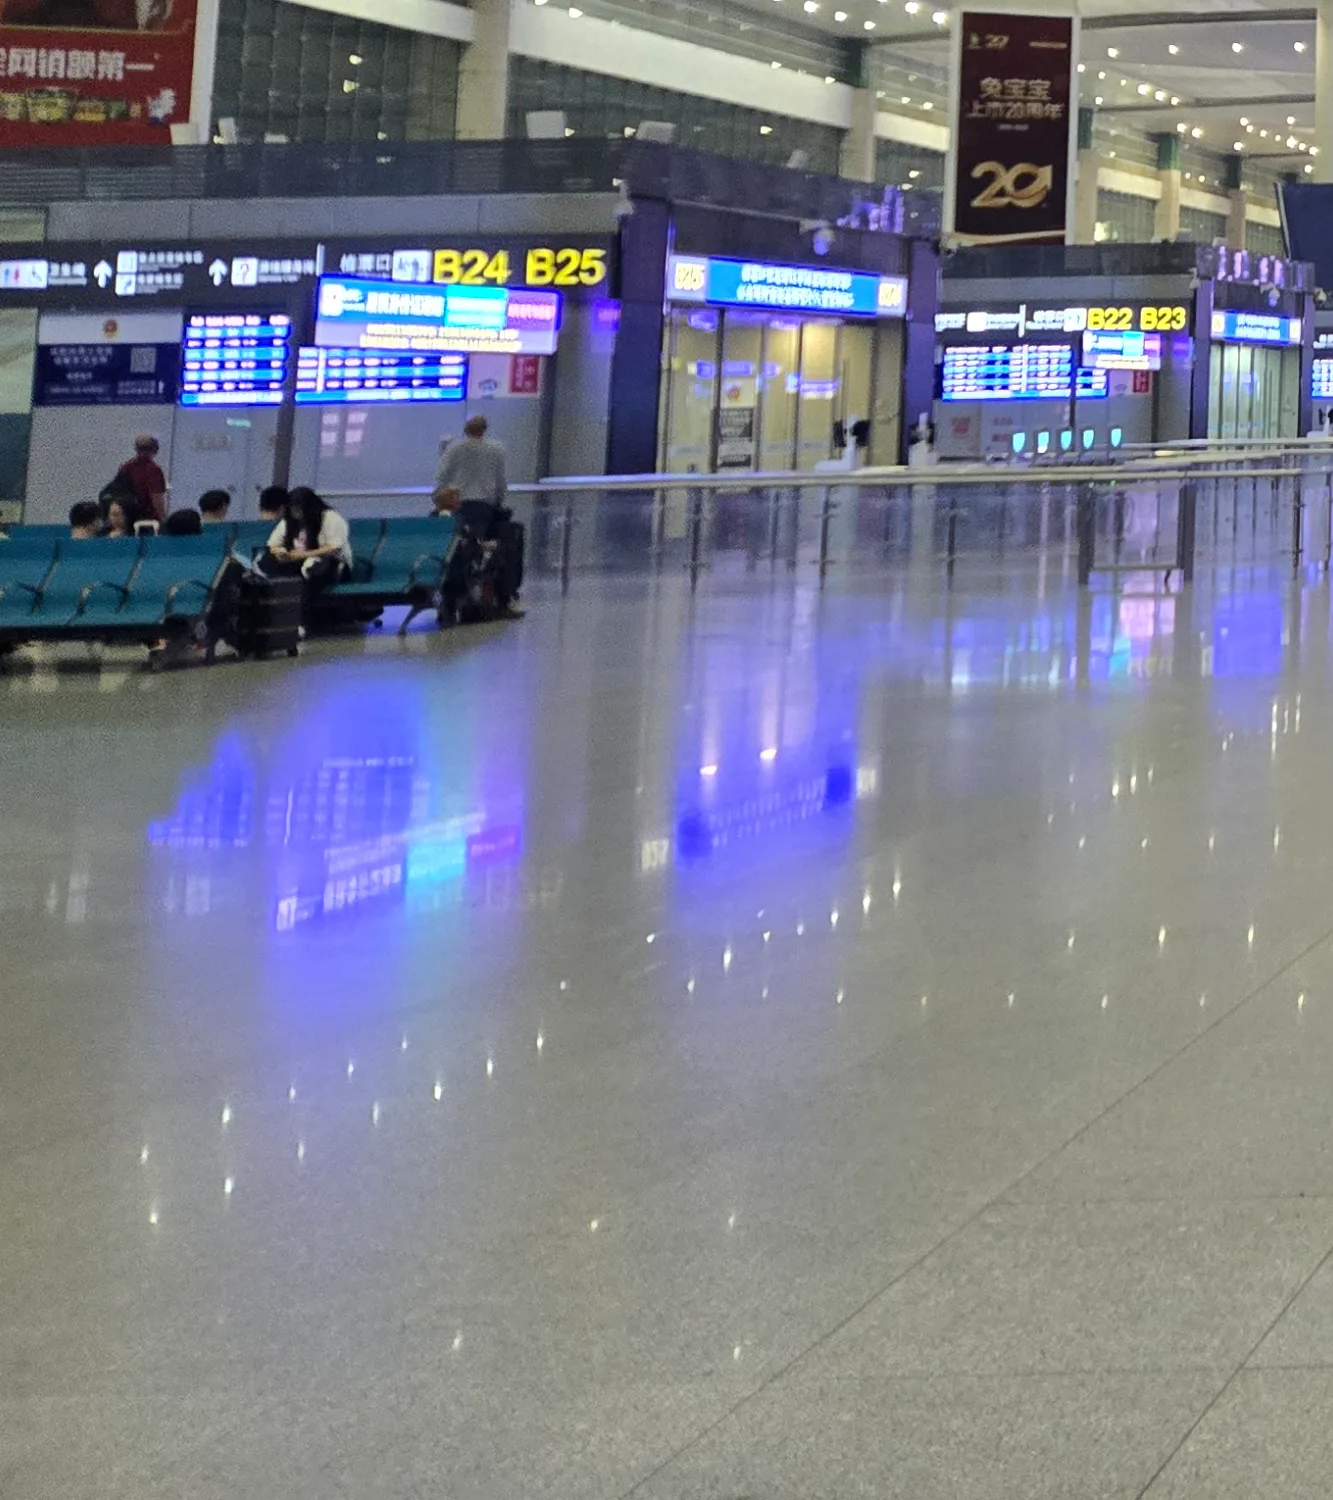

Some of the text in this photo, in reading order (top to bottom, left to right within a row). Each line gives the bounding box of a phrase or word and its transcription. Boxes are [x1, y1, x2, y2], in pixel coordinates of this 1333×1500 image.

[971, 161, 1053, 208] 20
[432, 248, 608, 285] B24 B25
[1088, 307, 1132, 330] B22
[1140, 307, 1187, 330] B23
